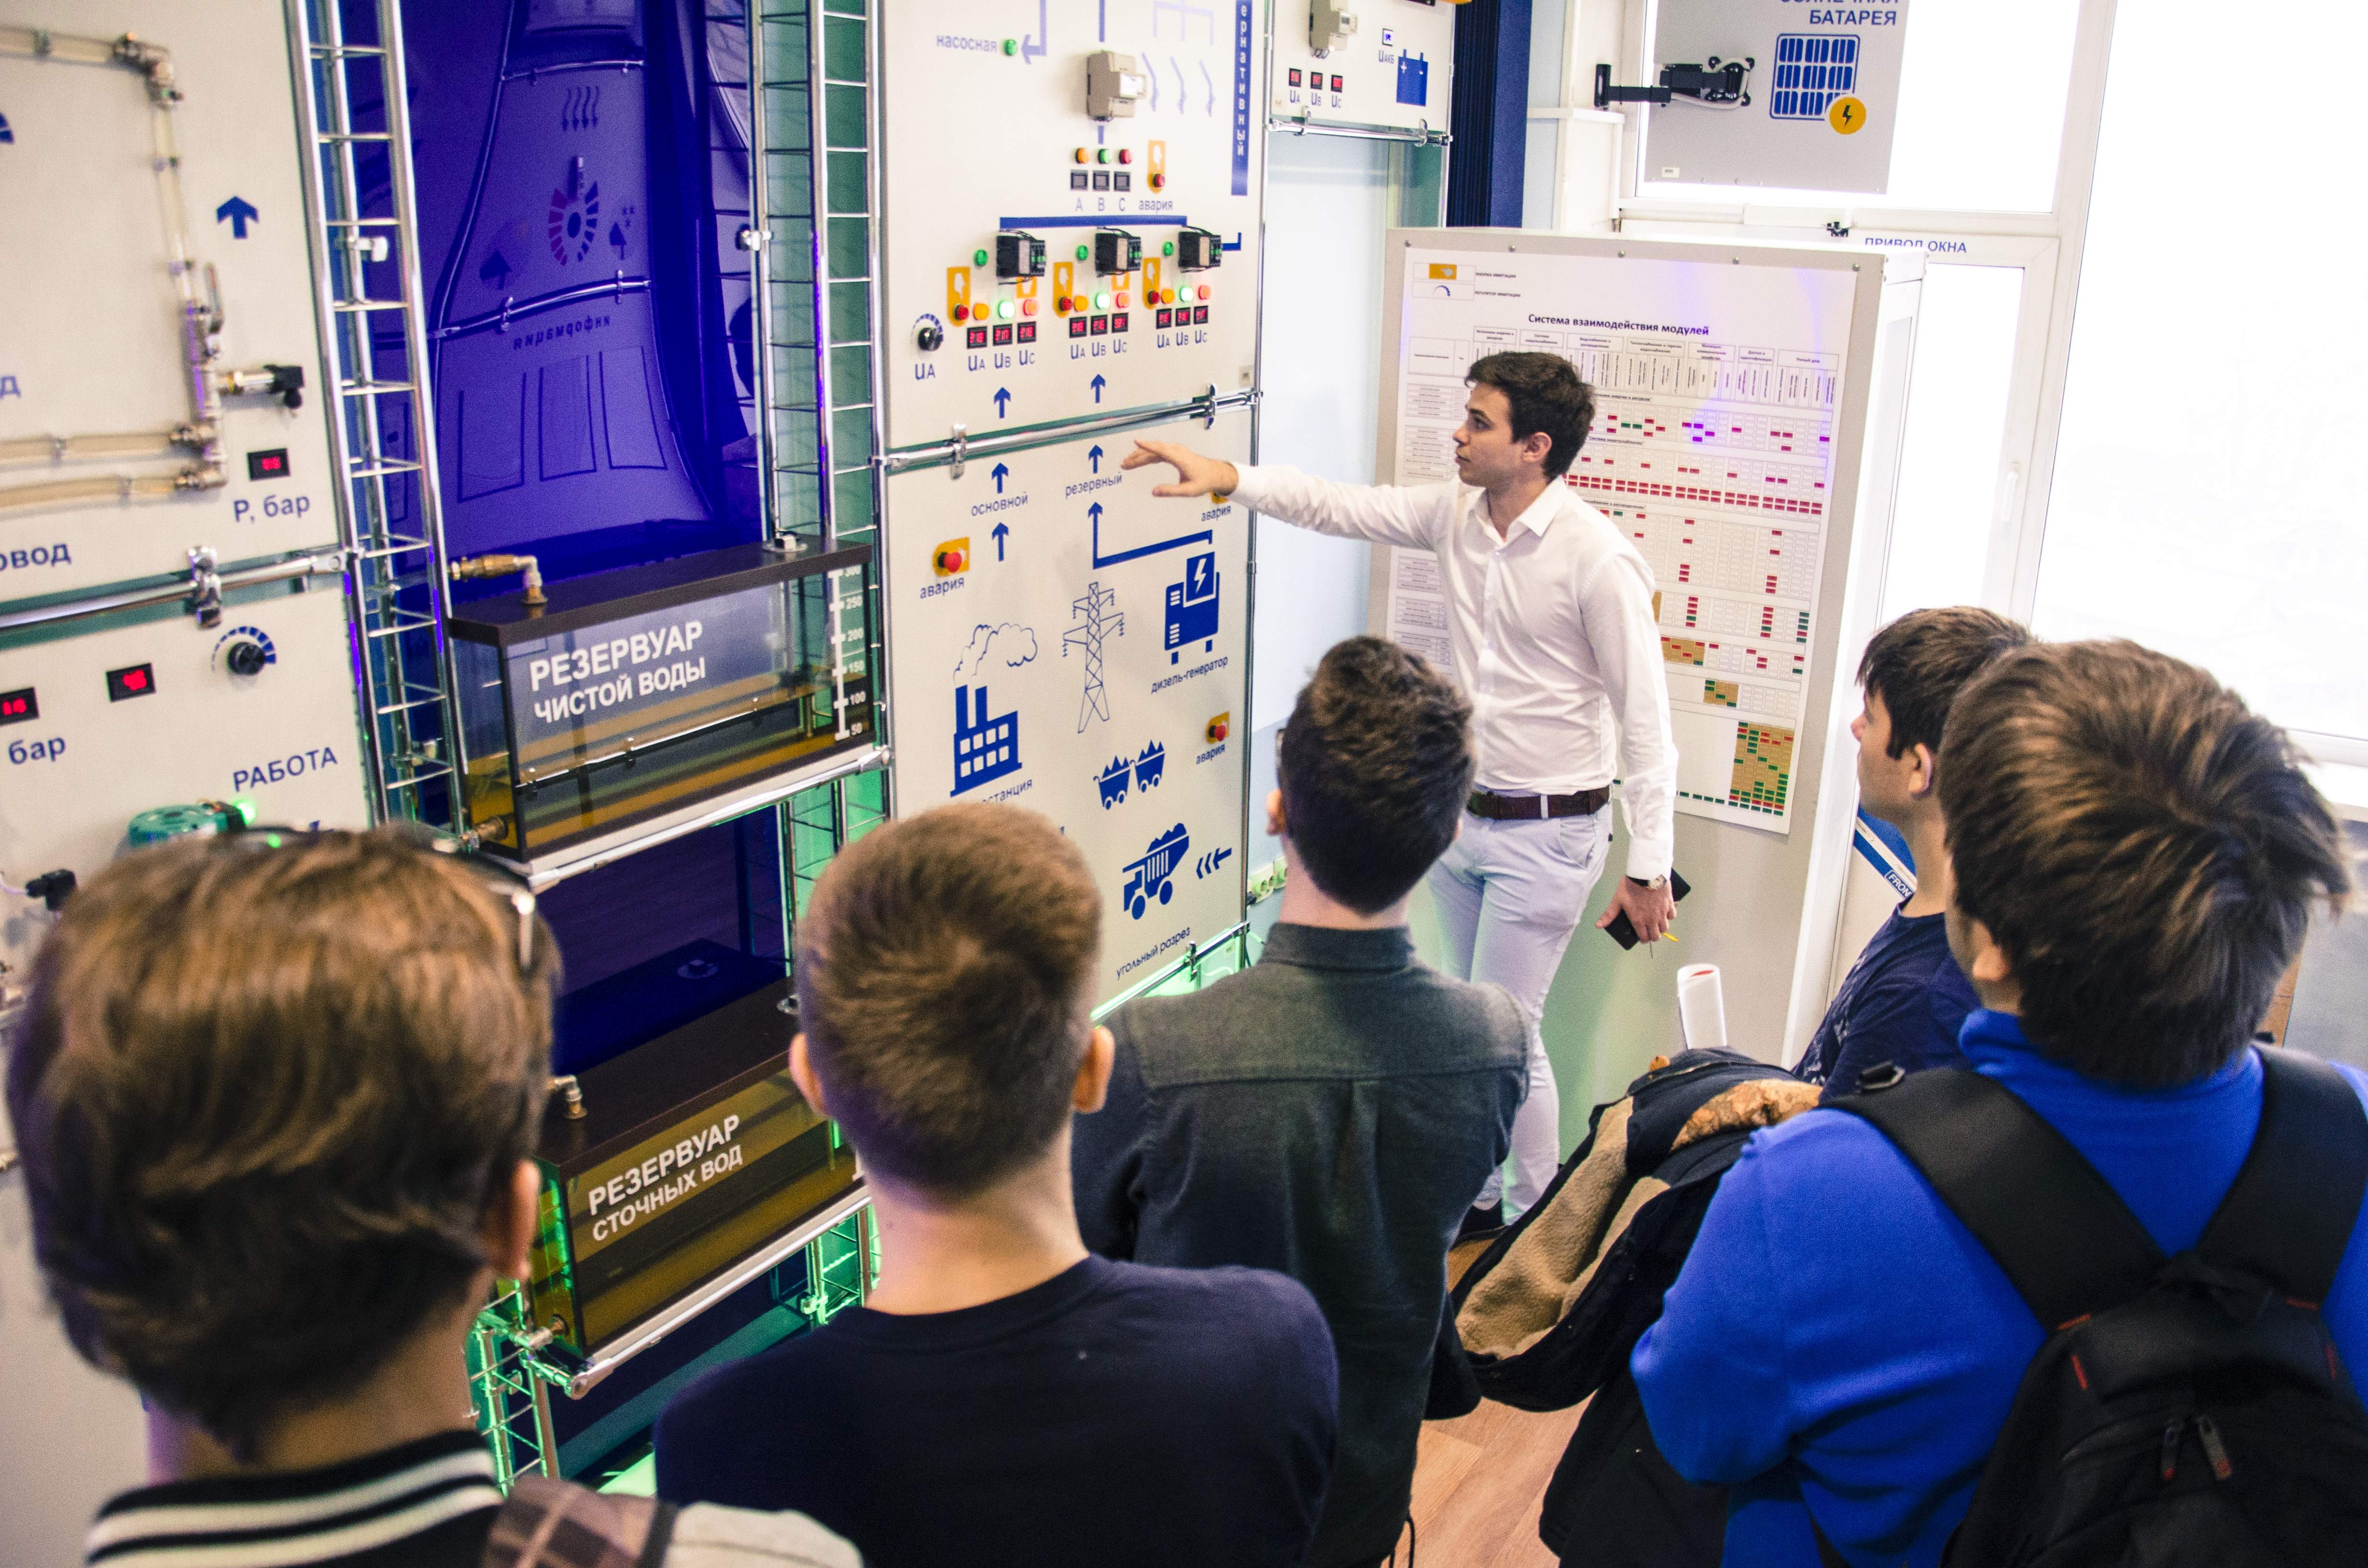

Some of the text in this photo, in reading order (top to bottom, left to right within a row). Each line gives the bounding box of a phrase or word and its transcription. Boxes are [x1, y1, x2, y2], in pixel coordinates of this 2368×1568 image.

[1809, 10, 1897, 25] БАТАРЕЯ
[936, 35, 997, 51] насосная
[1139, 199, 1173, 214] авария
[1928, 241, 1967, 253] ОКНА
[1528, 314, 1709, 336] Система взаимодействия модулей
[1065, 473, 1122, 498] резервный
[263, 493, 310, 518] бар
[971, 490, 1029, 517] основной
[1201, 505, 1231, 522] авария
[920, 577, 964, 600] авария
[846, 595, 862, 610] 250
[847, 627, 863, 642] 200
[529, 621, 703, 692] РЕЗЕРВУАР
[849, 660, 864, 673] 150
[1151, 656, 1228, 694] дизель-генератор
[533, 657, 706, 724] ЧИСТОЙ ВОДЫ
[850, 690, 866, 705] 100
[851, 722, 863, 735] 50
[8, 737, 66, 765] бар
[1196, 744, 1225, 764] авария
[233, 746, 338, 792] РАБОТА
[1116, 926, 1191, 981] угольный разрез
[589, 1115, 739, 1215] РЕЗЕРВУАР
[592, 1145, 743, 1241] СТОЧНЫХ ВОД
